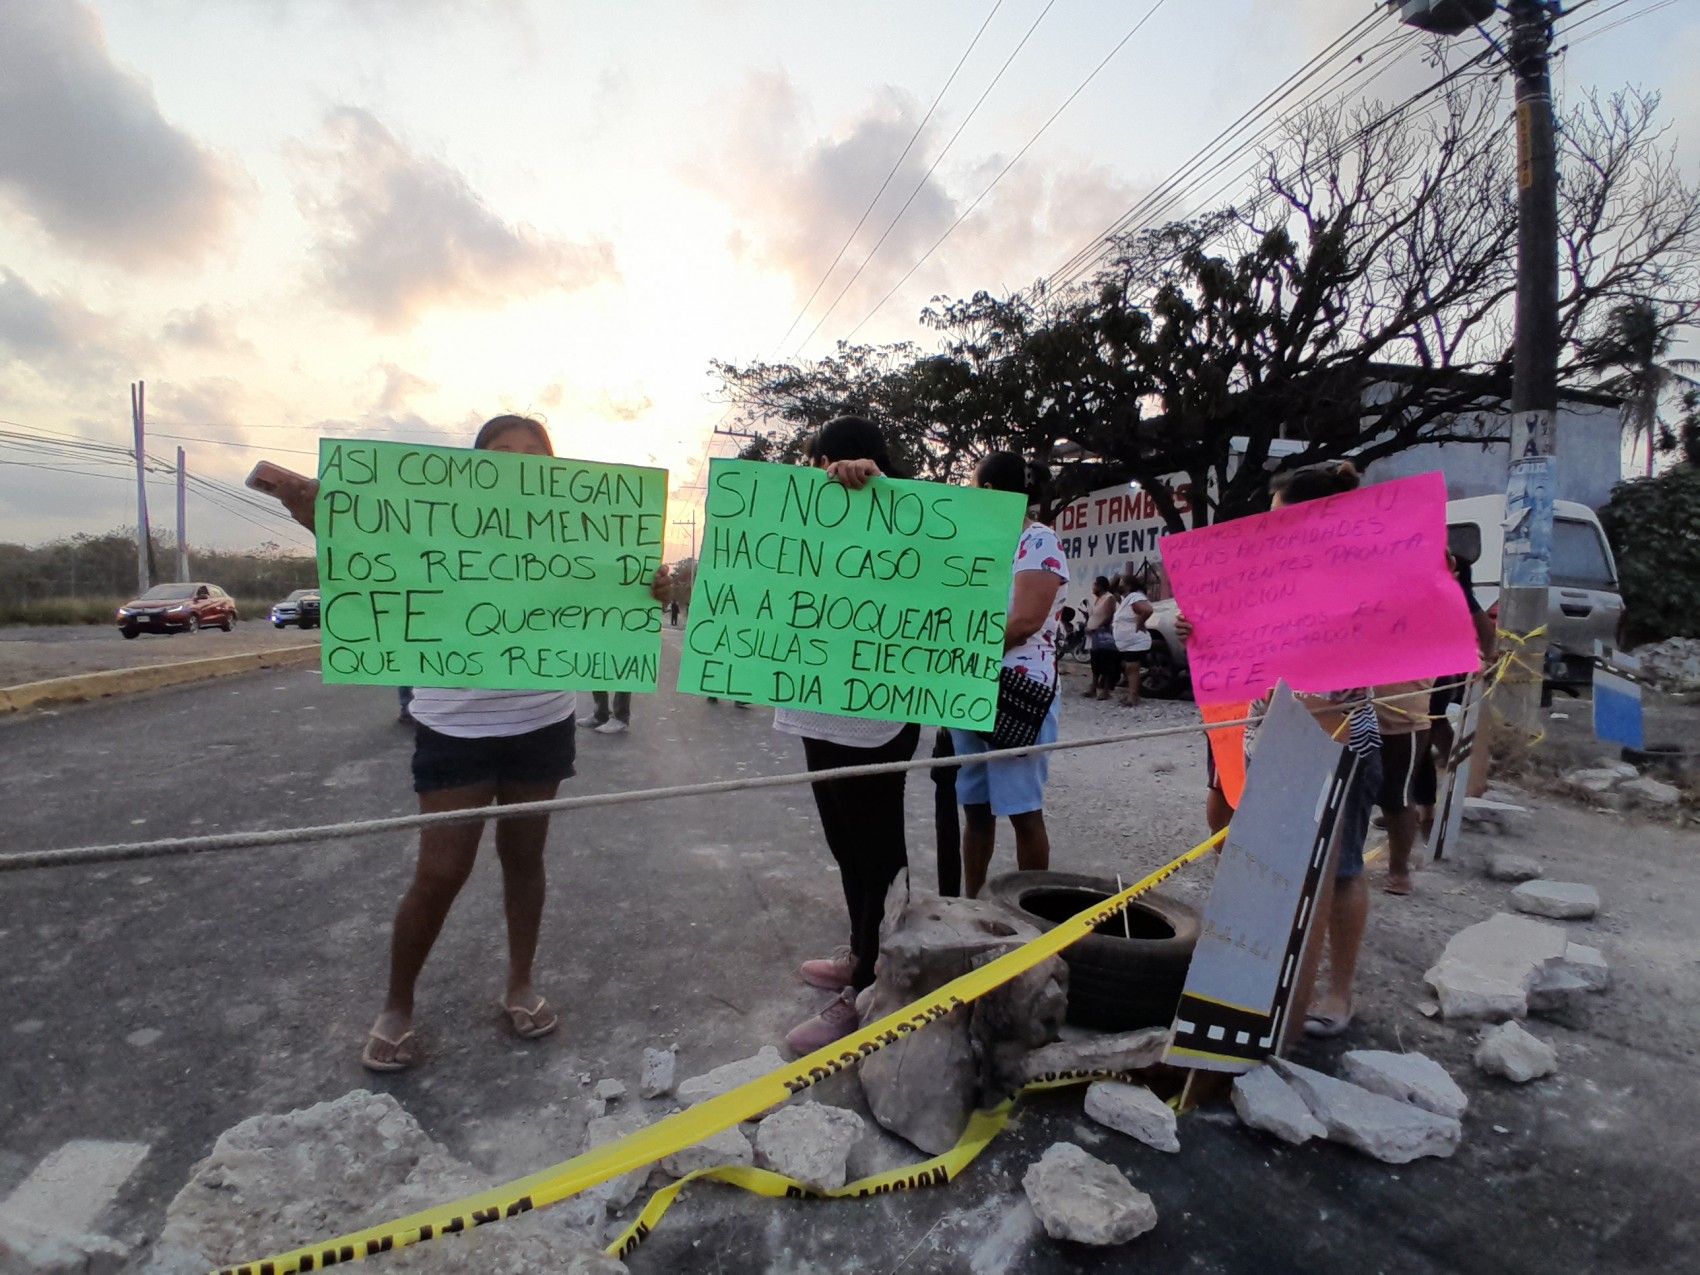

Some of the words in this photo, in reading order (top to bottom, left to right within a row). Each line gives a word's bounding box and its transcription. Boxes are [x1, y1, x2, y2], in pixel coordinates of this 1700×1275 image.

[320, 445, 377, 484] ASI
[398, 452, 498, 489] COMO
[324, 491, 662, 546] PUNTUALMENTE
[780, 474, 850, 528] NO
[867, 487, 957, 540] NOS
[1062, 503, 1088, 531] DE
[713, 526, 824, 577] HACEN
[835, 545, 920, 581] CASO
[941, 556, 995, 587] SE
[1088, 534, 1098, 557] Y
[1187, 550, 1228, 570] LAS
[1237, 516, 1385, 560] AUTORIDADES
[1325, 532, 1423, 566] PRONTA
[327, 547, 397, 582] LOS
[420, 550, 596, 583] RECIBOS
[616, 555, 662, 586] DE
[325, 589, 444, 643] CFE
[465, 602, 662, 636] Queremos
[704, 580, 739, 616] VA
[757, 589, 773, 620] A
[689, 619, 828, 666] CASILLAS
[1391, 615, 1408, 635] A
[329, 646, 400, 675] QUE
[420, 650, 485, 677] NOS
[500, 646, 657, 684] RESUELVAN
[1199, 662, 1266, 692] CFE
[699, 660, 752, 696] EL
[768, 671, 822, 705] DIA
[841, 678, 992, 722] DOMINGO
